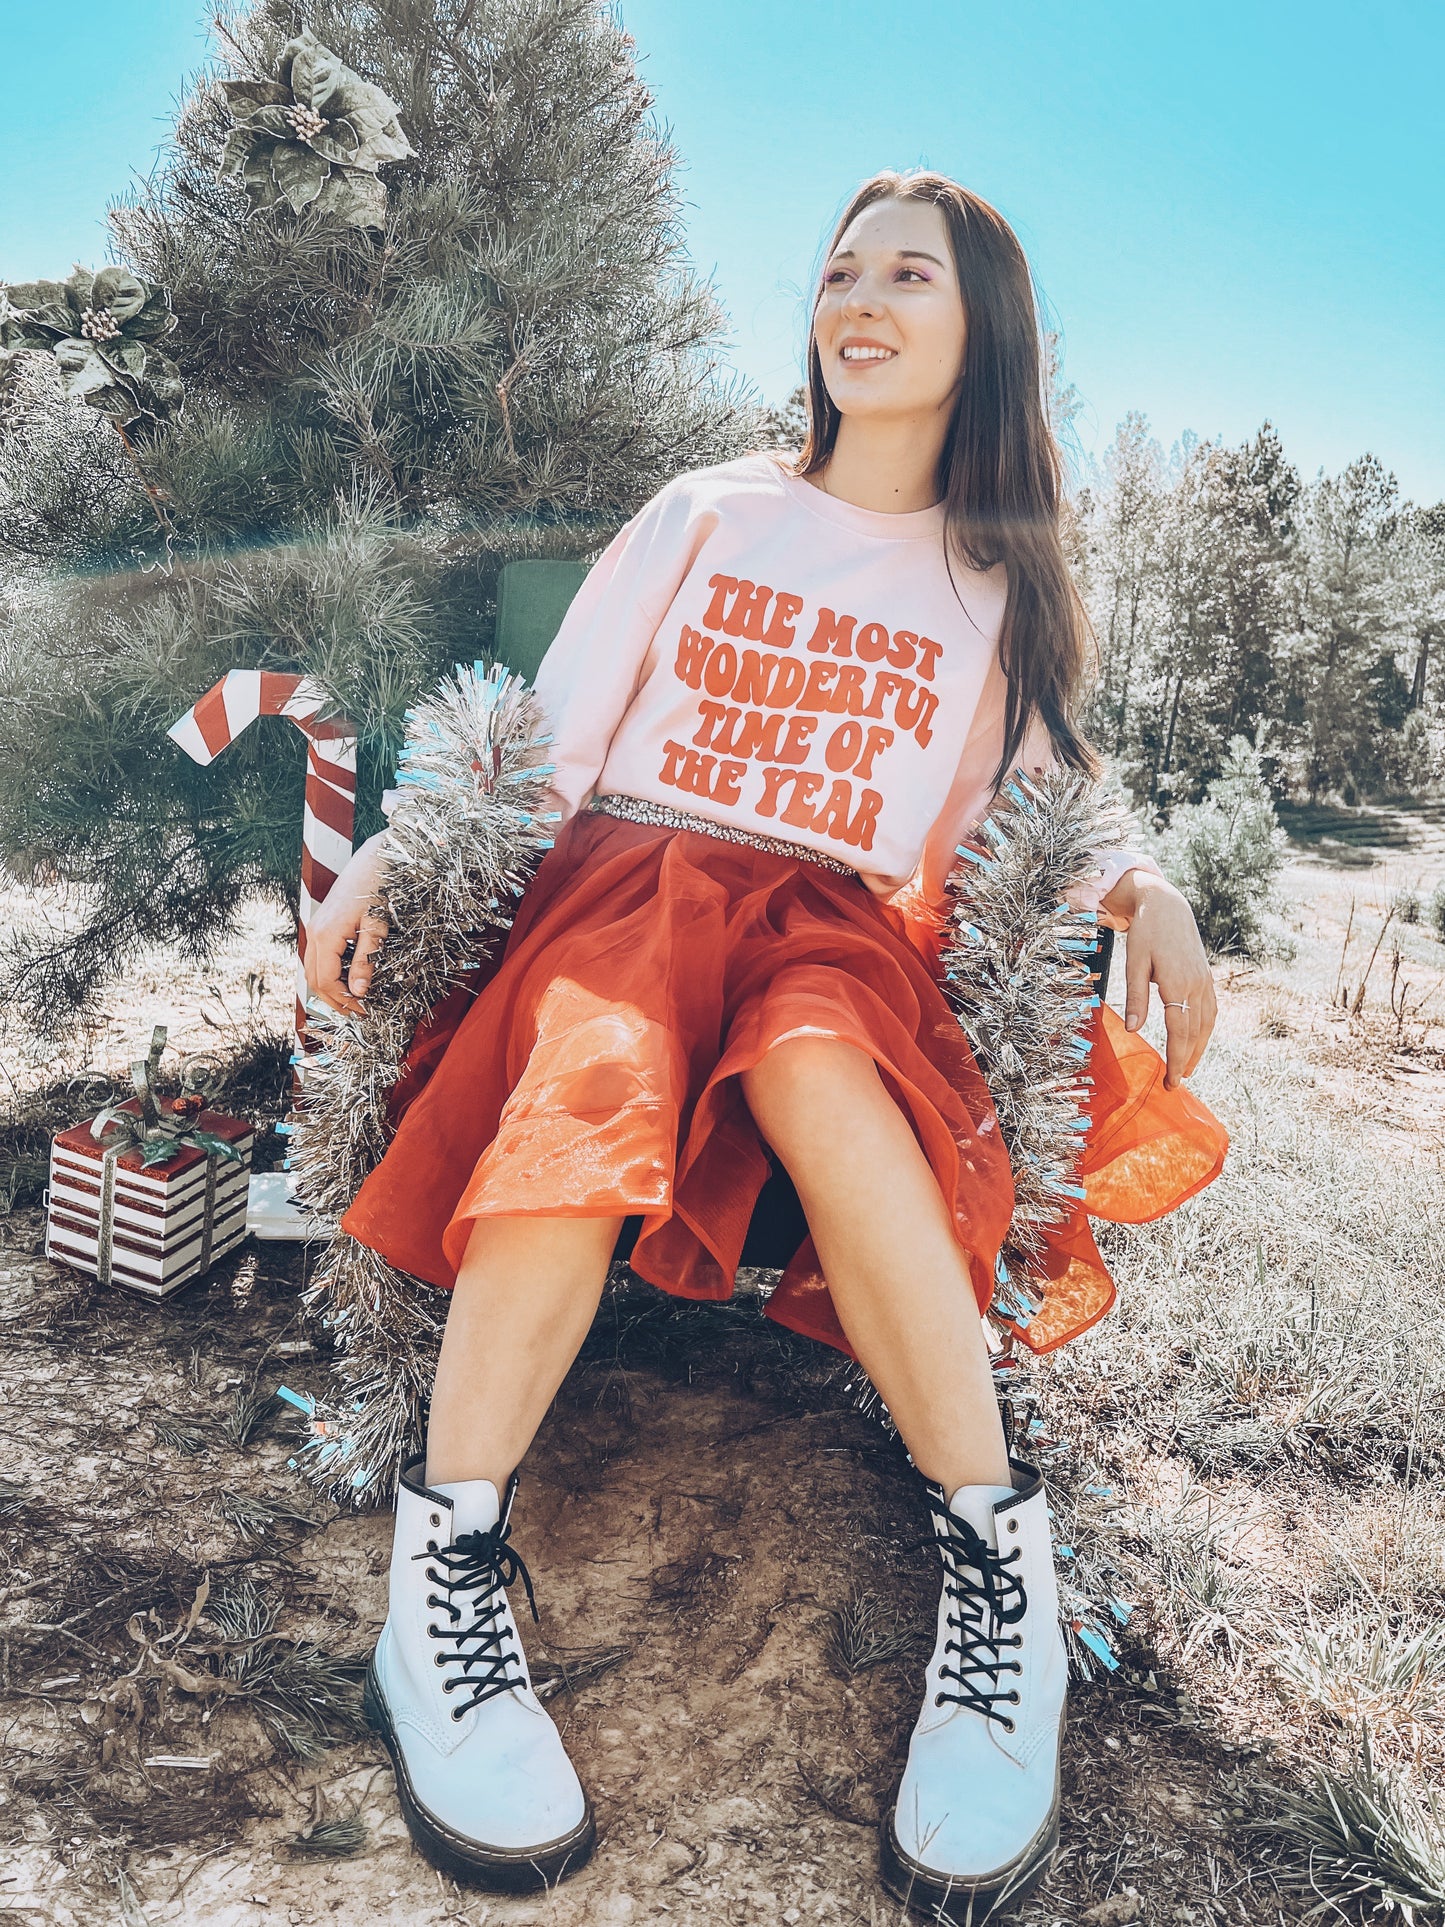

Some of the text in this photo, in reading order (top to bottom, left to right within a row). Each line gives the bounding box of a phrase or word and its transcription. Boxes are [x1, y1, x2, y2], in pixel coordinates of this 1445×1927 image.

[702, 573, 943, 682] THE MOST
[674, 624, 940, 750] WONDERFUL
[692, 699, 894, 781] TIME OF
[658, 739, 883, 852] THE YEAR
